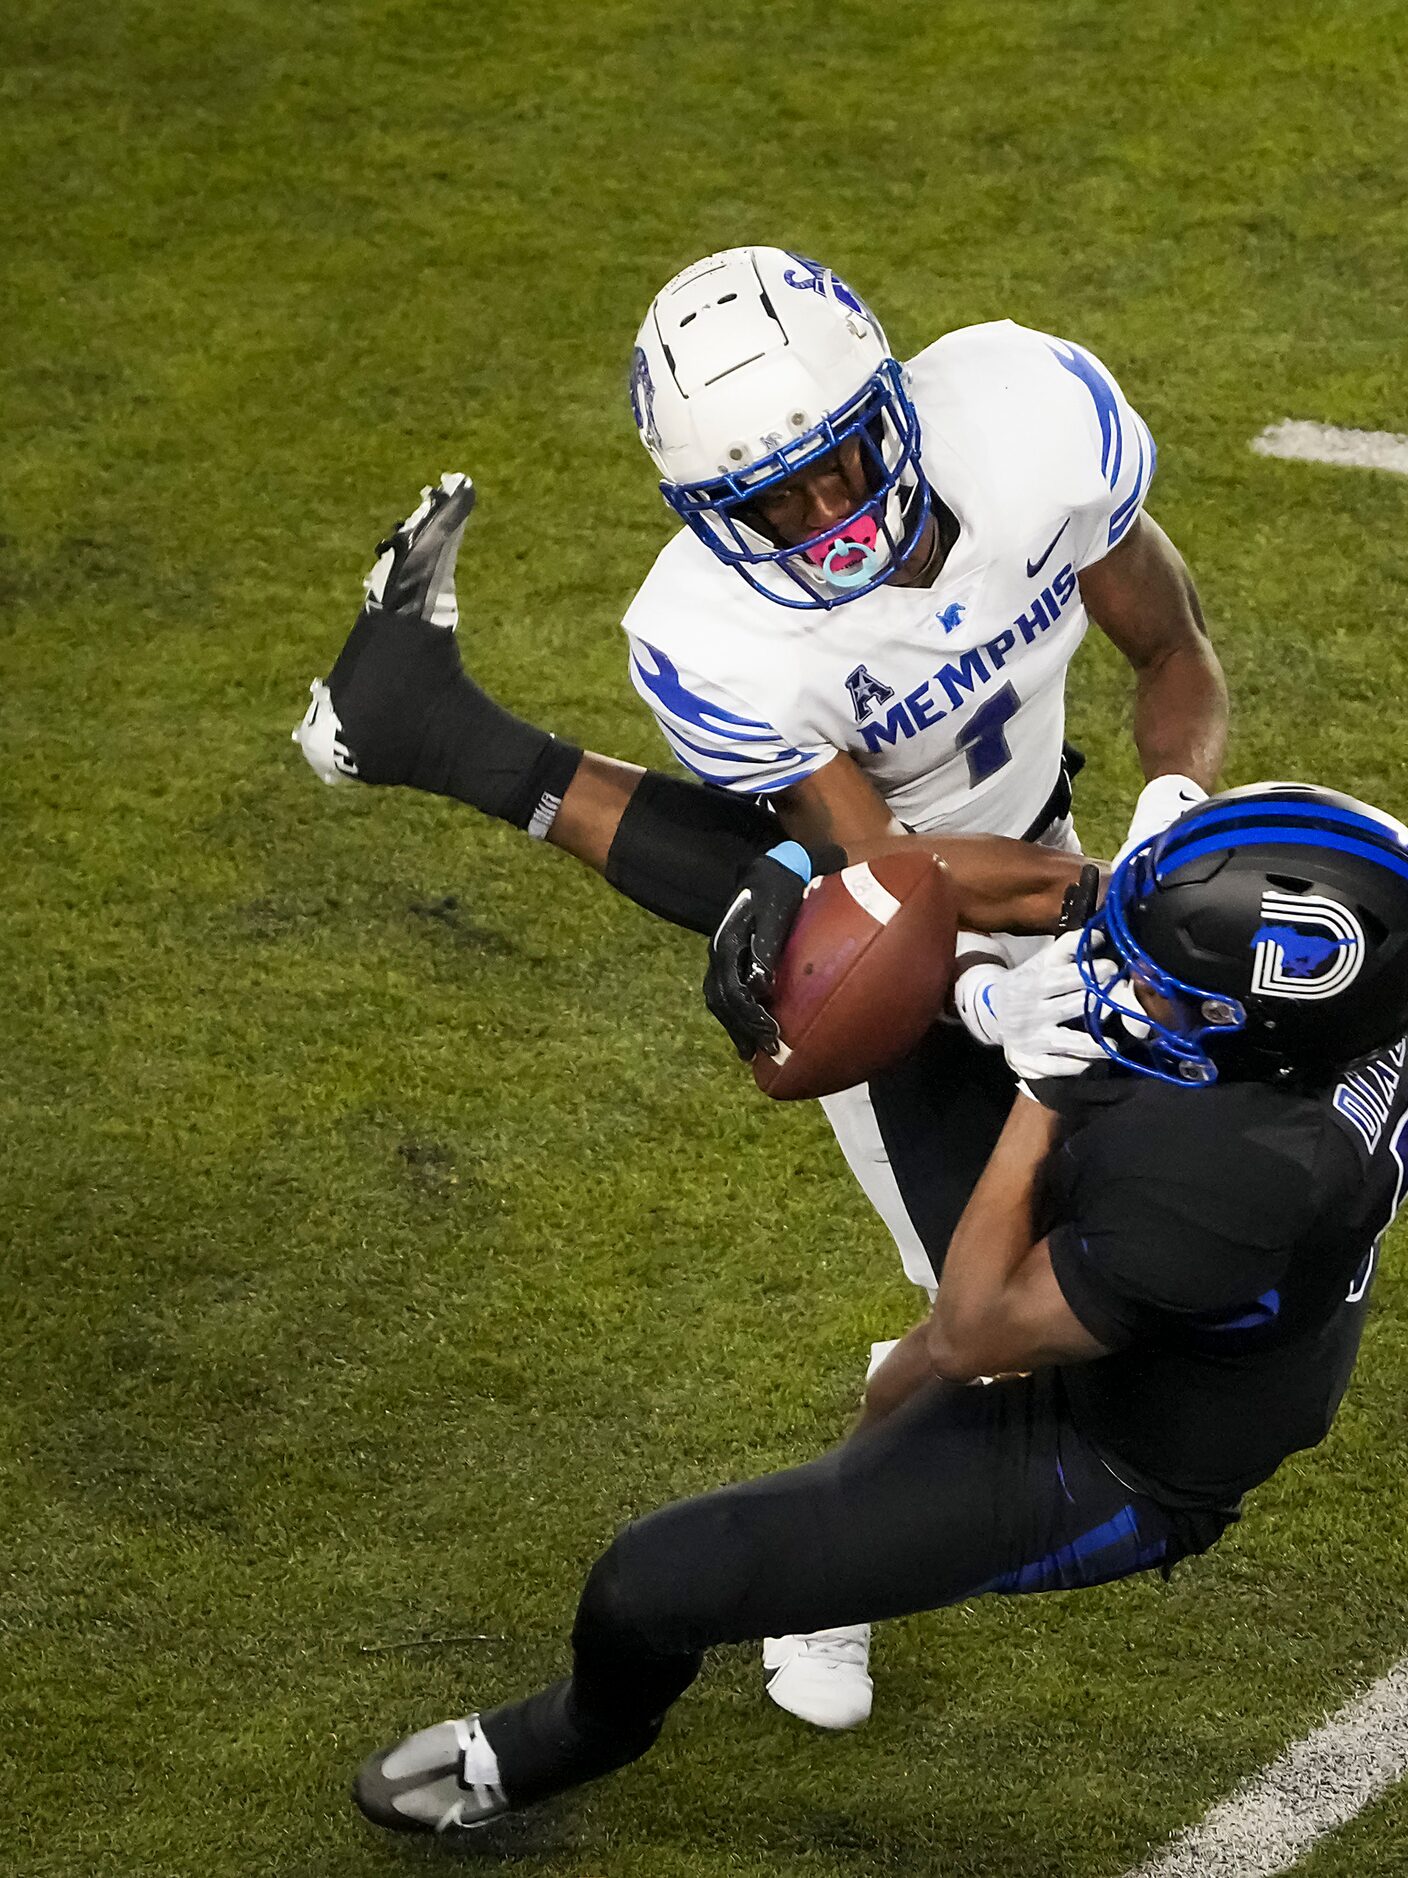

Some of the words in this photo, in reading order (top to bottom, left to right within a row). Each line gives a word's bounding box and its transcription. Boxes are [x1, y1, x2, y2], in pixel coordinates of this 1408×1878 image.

[845, 664, 895, 724] A
[857, 563, 1076, 753] MEMPHIS
[955, 679, 1022, 790] 1
